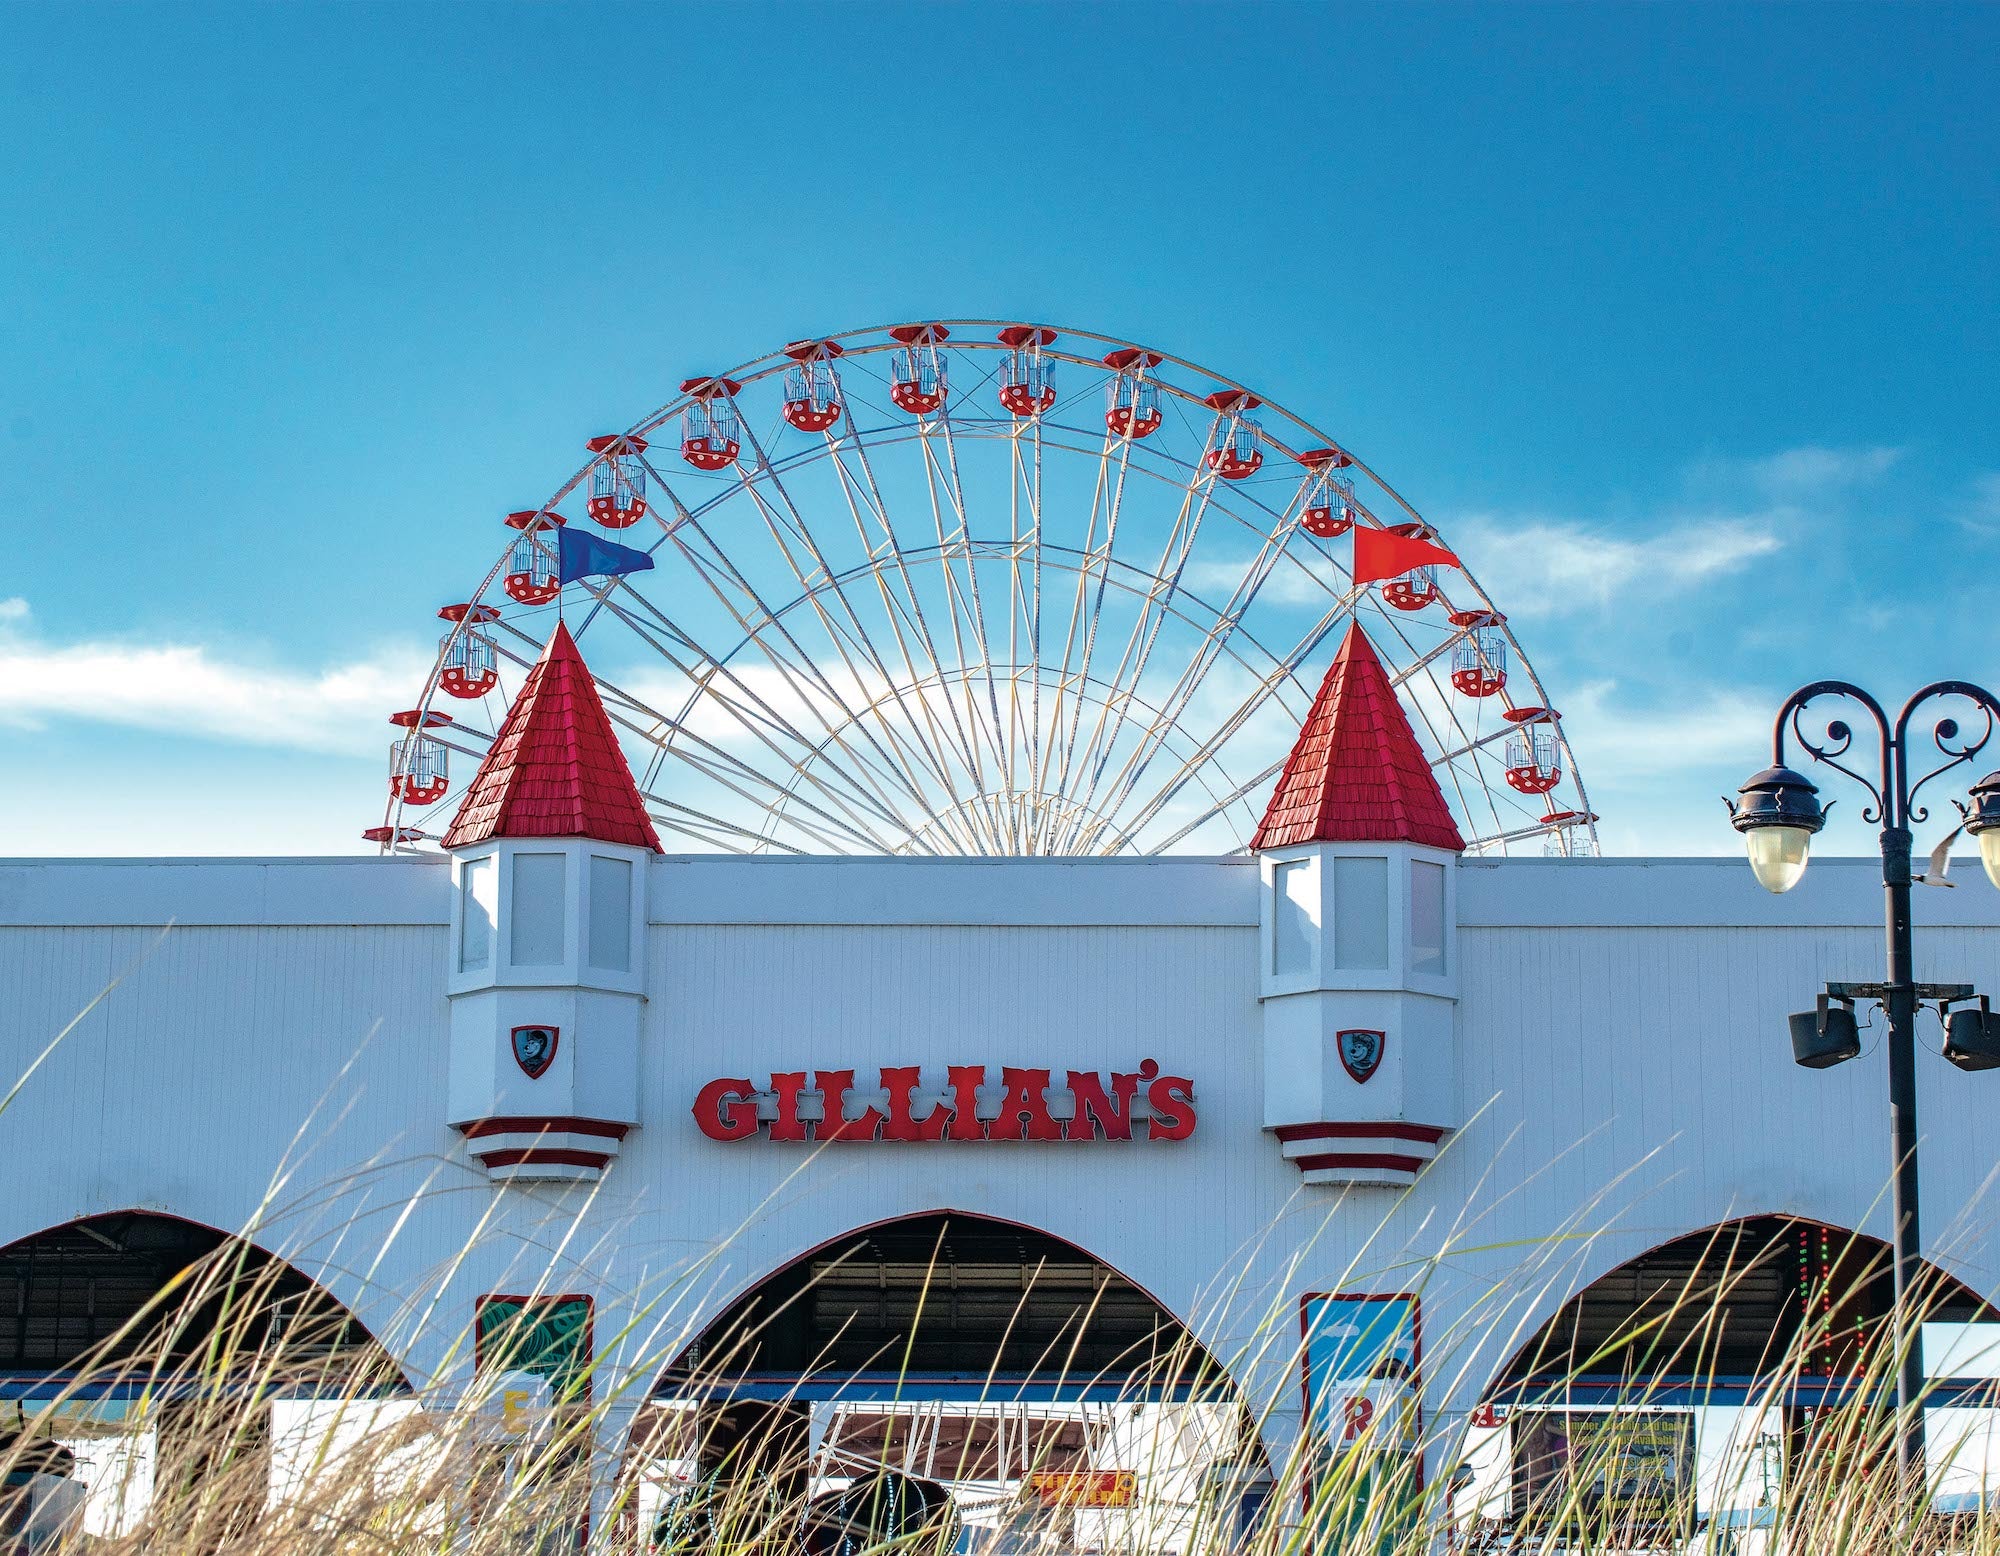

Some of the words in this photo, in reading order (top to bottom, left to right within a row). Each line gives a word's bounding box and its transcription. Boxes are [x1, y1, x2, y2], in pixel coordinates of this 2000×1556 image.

[691, 1058, 1198, 1142] GILLIAN'S
[504, 1391, 529, 1434] E
[1344, 1396, 1374, 1440] R
